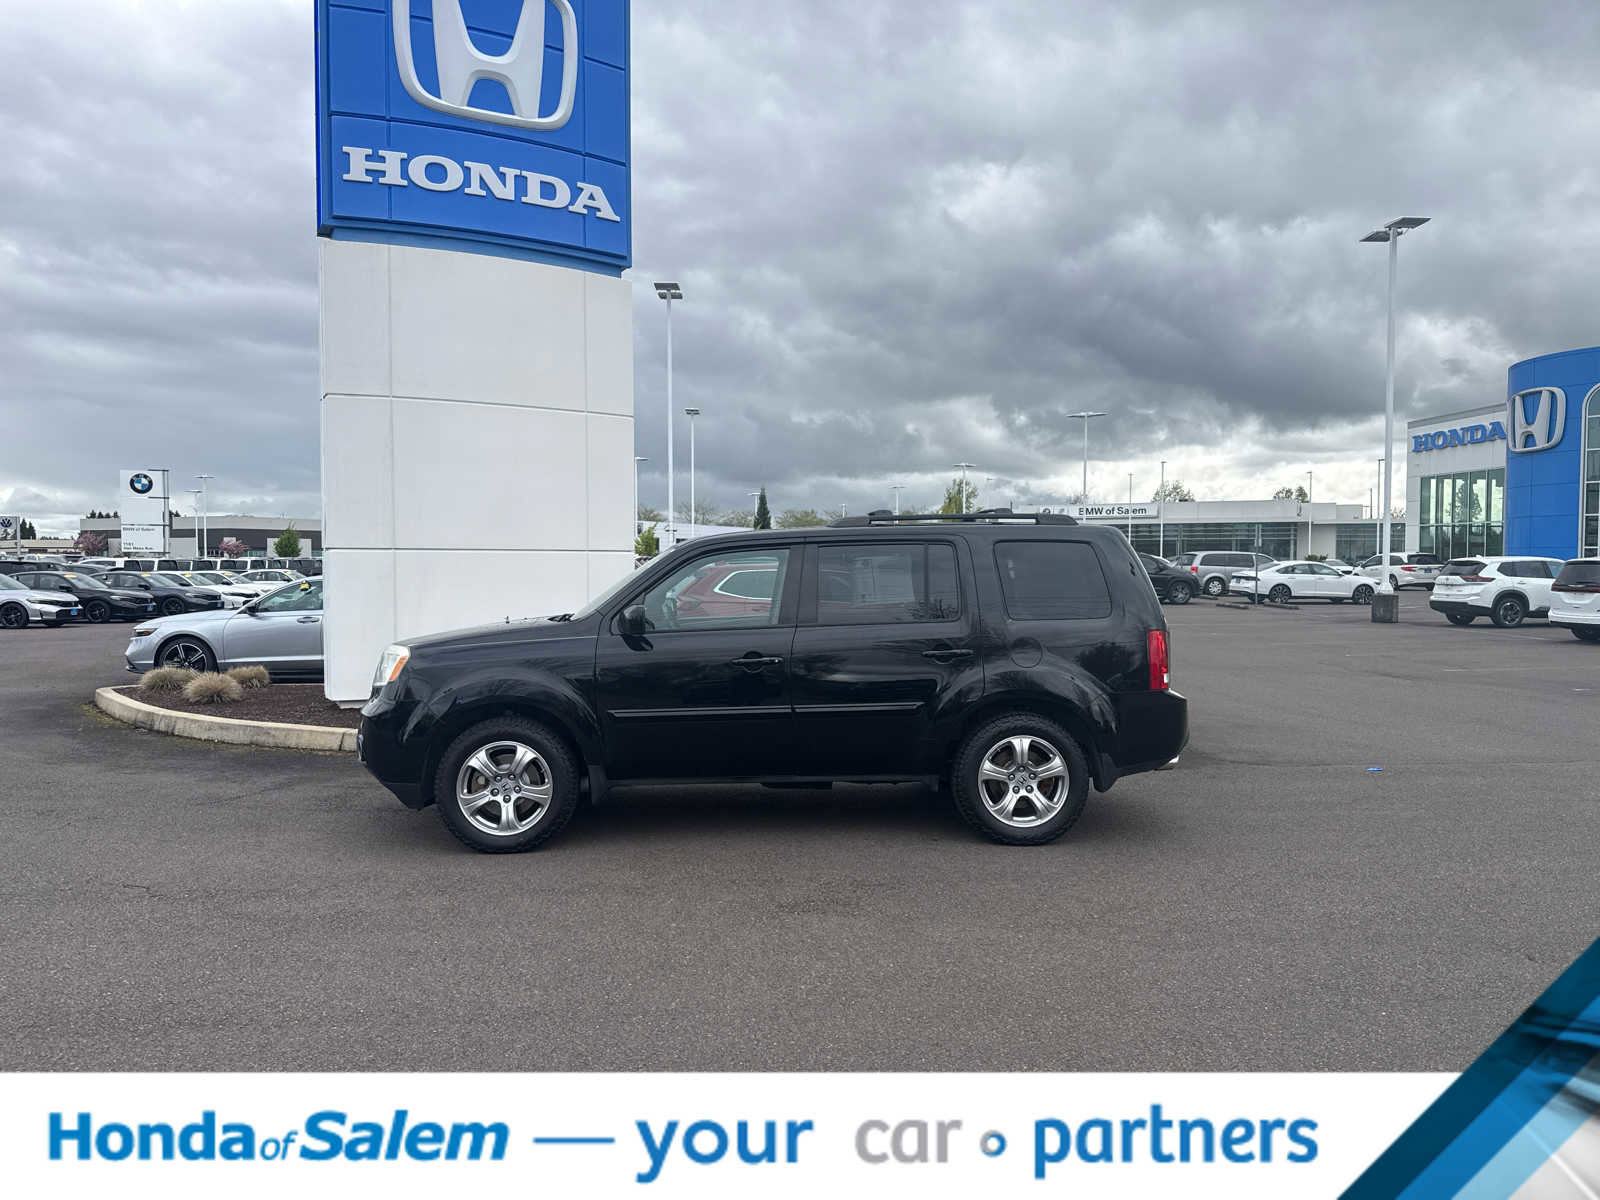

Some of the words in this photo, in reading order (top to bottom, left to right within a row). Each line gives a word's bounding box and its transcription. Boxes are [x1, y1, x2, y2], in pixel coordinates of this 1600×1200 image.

[342, 146, 621, 222] HONDA
[1412, 421, 1507, 453] HONDA
[1105, 506, 1116, 515] of
[1117, 506, 1146, 515] Saem
